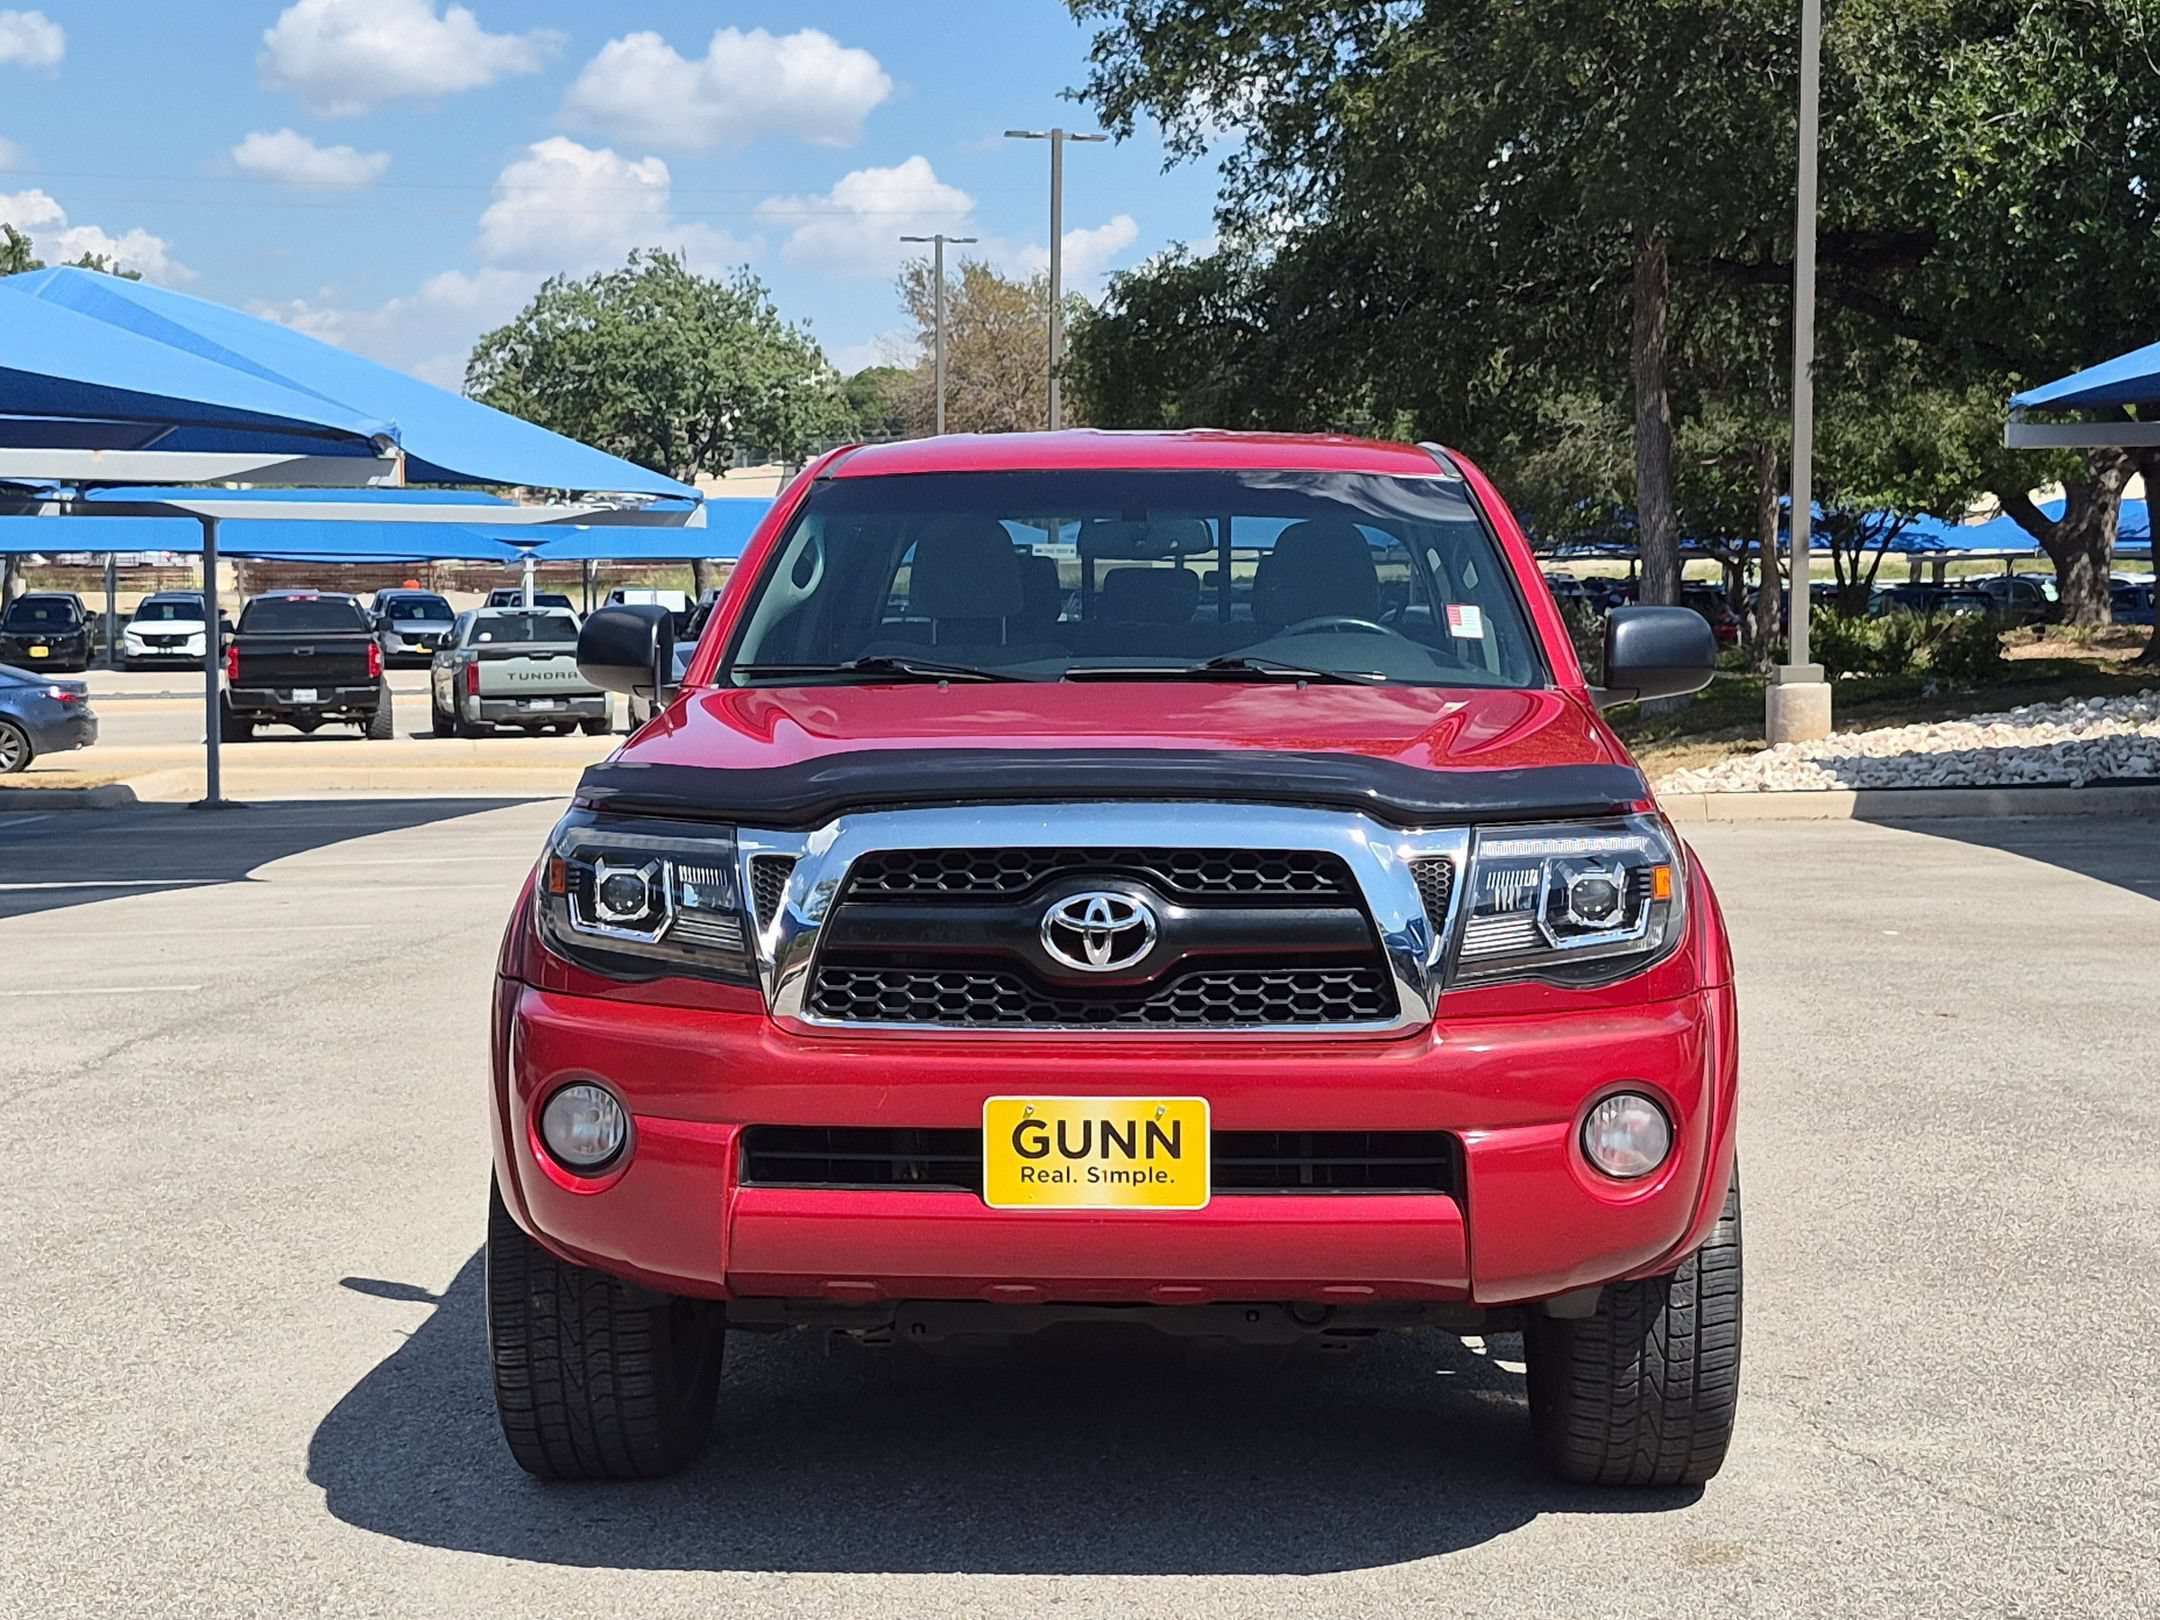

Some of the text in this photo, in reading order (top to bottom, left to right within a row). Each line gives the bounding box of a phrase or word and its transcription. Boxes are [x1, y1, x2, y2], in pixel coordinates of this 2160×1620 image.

[507, 671, 578, 680] TUNDRA
[1012, 1119, 1181, 1159] GUNN
[1020, 1165, 1175, 1187] Real. Simple.
